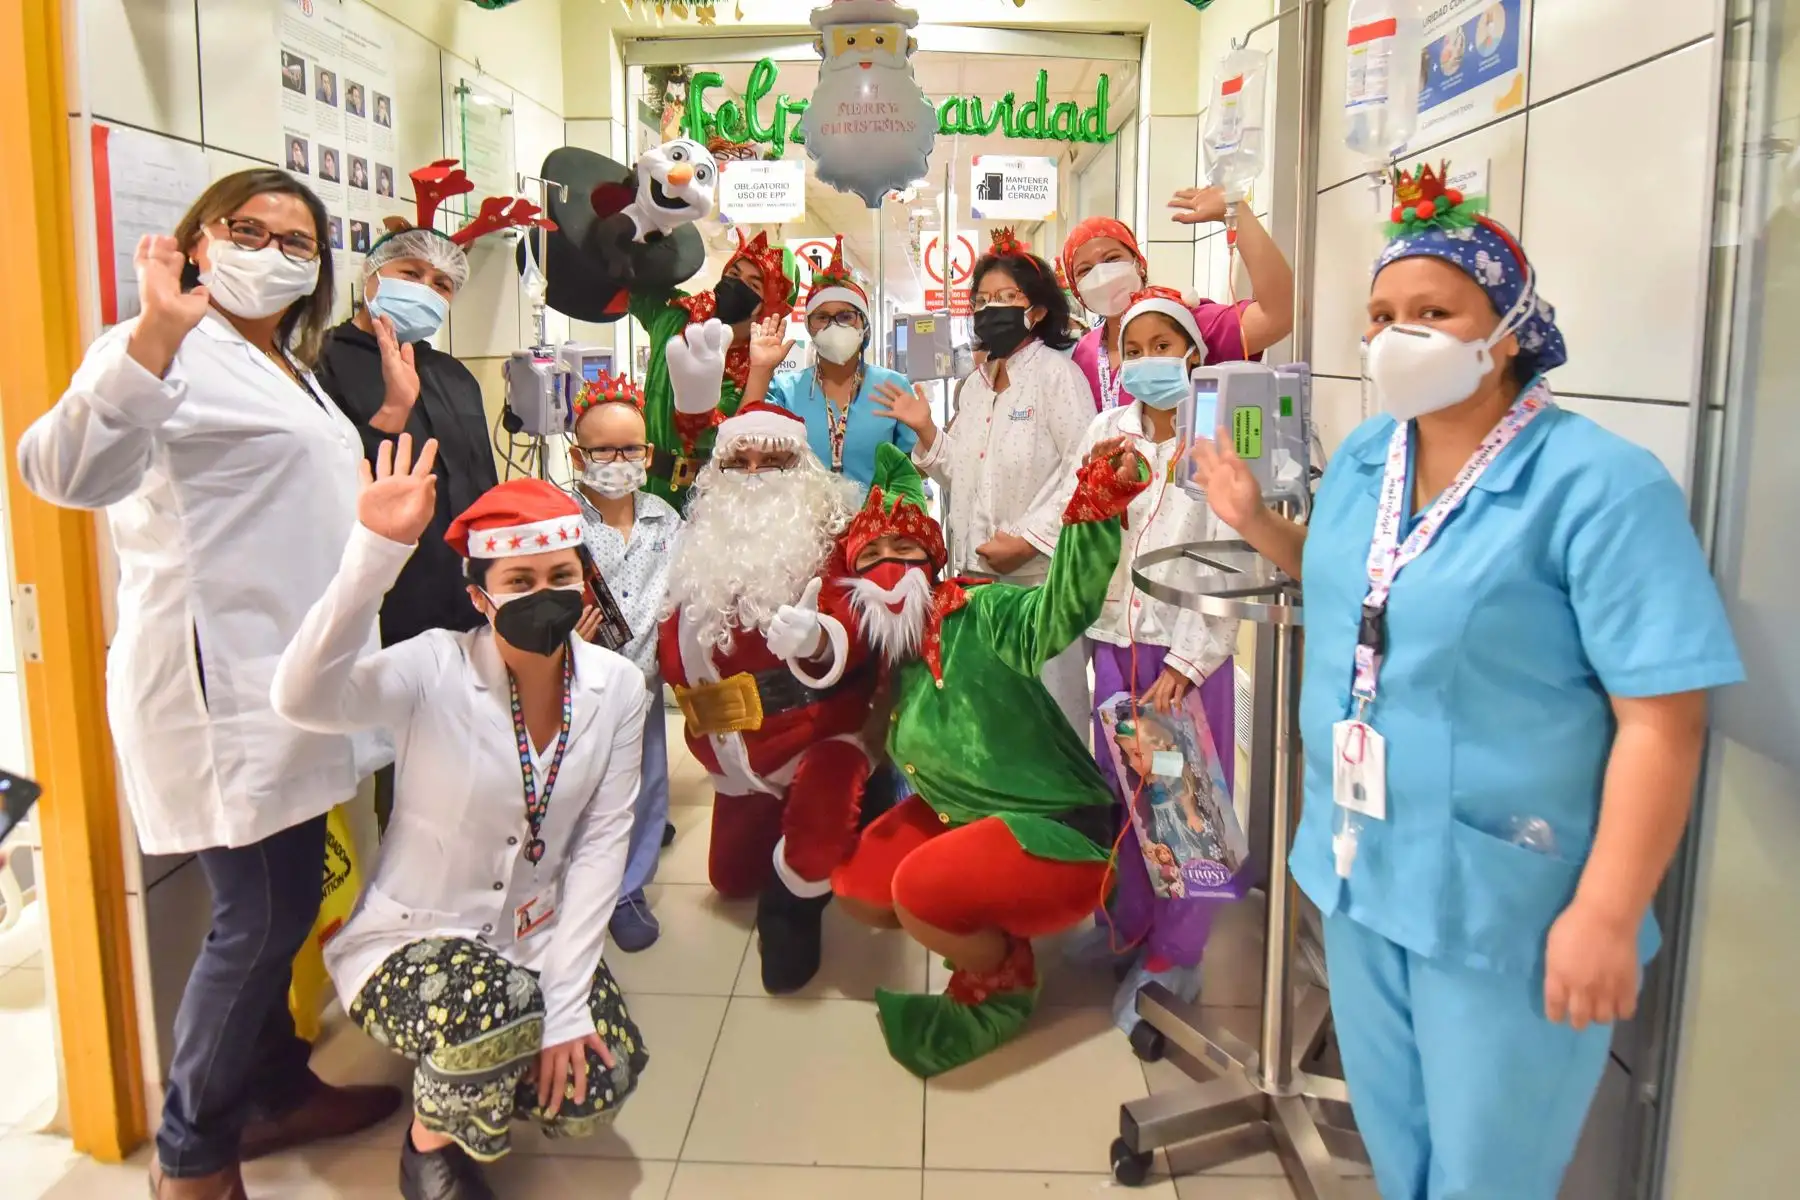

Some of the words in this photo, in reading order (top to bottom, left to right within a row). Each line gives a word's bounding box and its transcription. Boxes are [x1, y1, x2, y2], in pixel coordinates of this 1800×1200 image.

[837, 102, 898, 117] MERRY
[935, 68, 1119, 144] avidad
[821, 119, 916, 136] CHRISTMAS
[1005, 176, 1050, 185] MANTENER
[734, 183, 790, 191] OBLIGATORIO
[1005, 184, 1016, 192] LA
[1017, 184, 1049, 193] PUERTA
[737, 192, 755, 200] USO
[757, 191, 768, 199] DE
[770, 191, 786, 199] EPP
[1007, 192, 1047, 201] CERRADA
